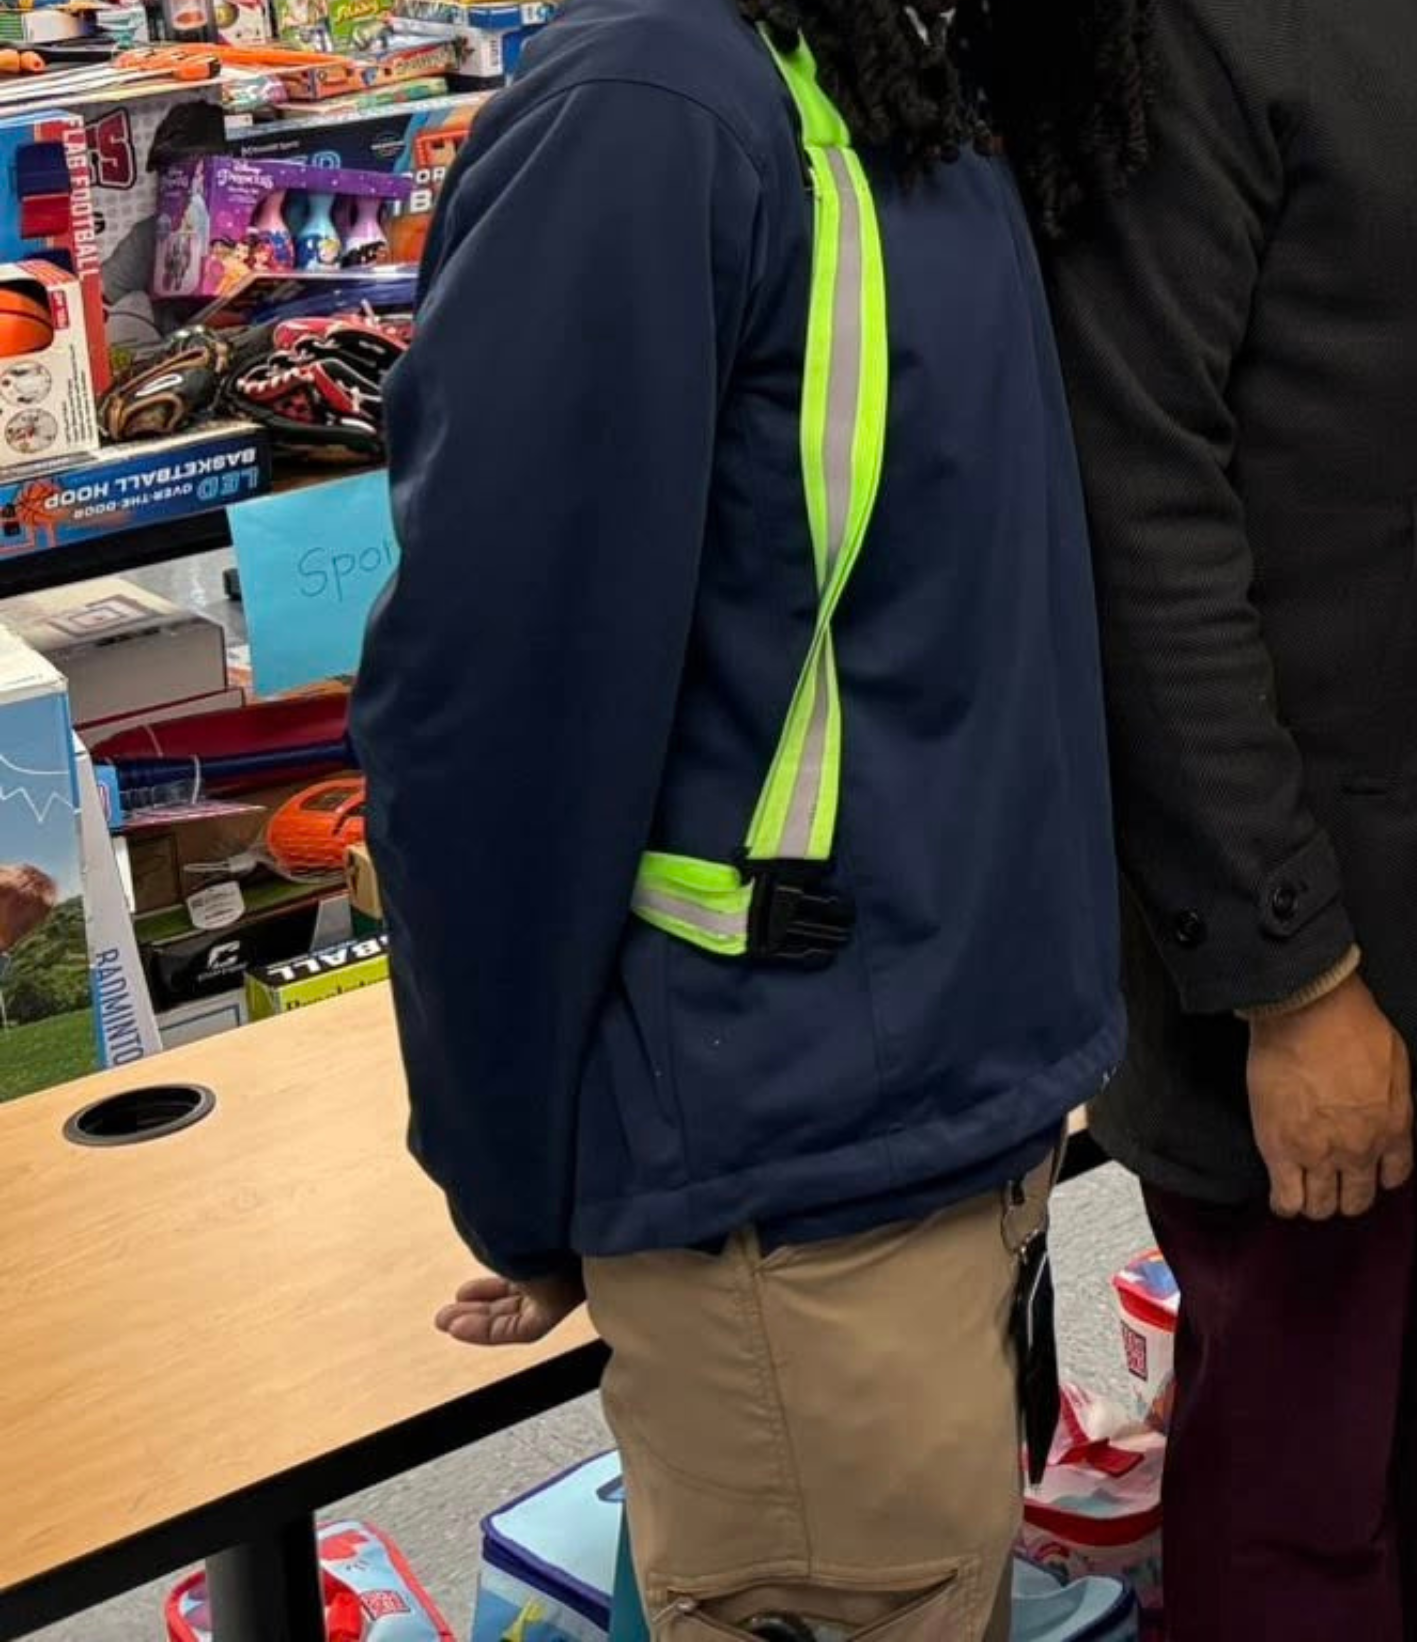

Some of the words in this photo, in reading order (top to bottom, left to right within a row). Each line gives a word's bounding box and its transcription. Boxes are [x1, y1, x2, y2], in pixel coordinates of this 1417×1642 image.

[62, 115, 87, 169] FLAG
[70, 172, 100, 280] FOOTBALL
[115, 447, 257, 494] BASKETBALL
[197, 466, 259, 501] LED
[44, 483, 109, 509] HOOP
